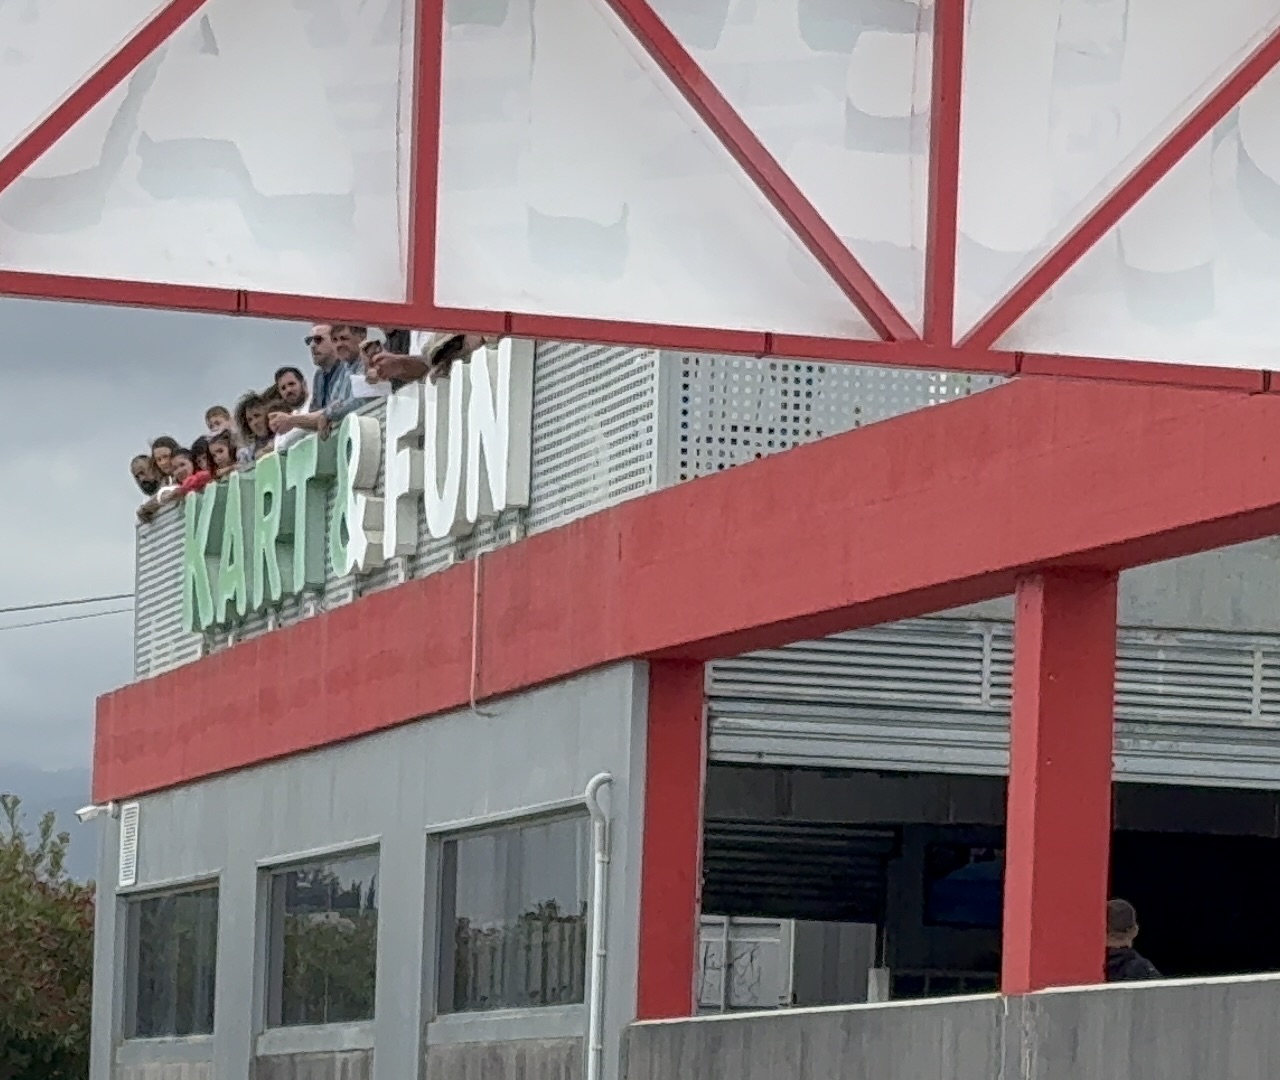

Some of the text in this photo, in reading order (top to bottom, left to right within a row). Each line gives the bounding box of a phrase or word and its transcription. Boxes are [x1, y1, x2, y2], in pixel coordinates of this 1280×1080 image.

[182, 338, 512, 633] KART & FUN
